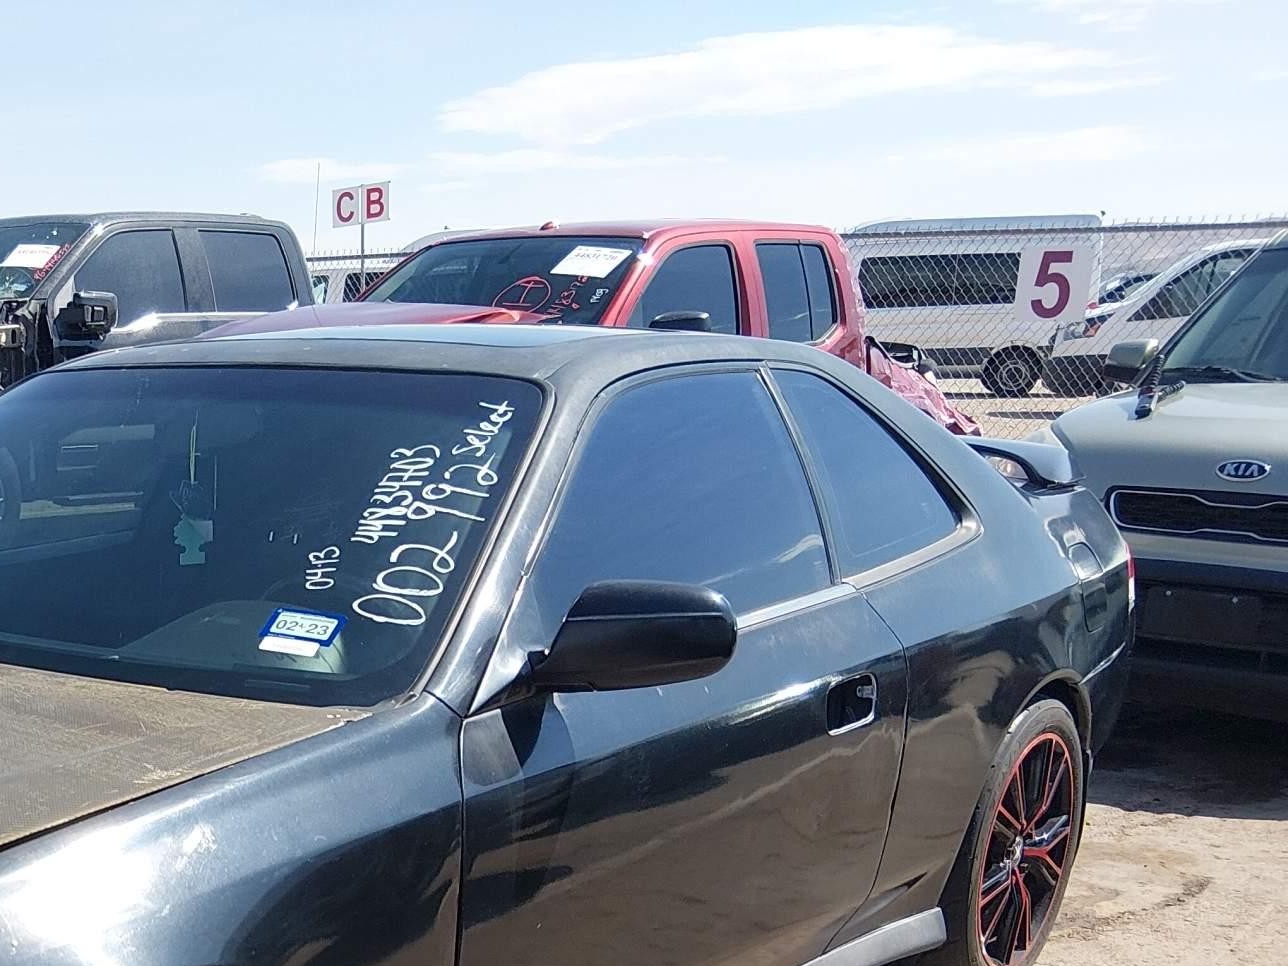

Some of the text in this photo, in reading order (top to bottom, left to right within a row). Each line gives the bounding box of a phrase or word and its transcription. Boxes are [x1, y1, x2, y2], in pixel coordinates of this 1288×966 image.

[336, 187, 385, 223] C B
[1030, 250, 1074, 319] 5
[350, 444, 441, 544] 44834703
[1223, 463, 1259, 477] KIA
